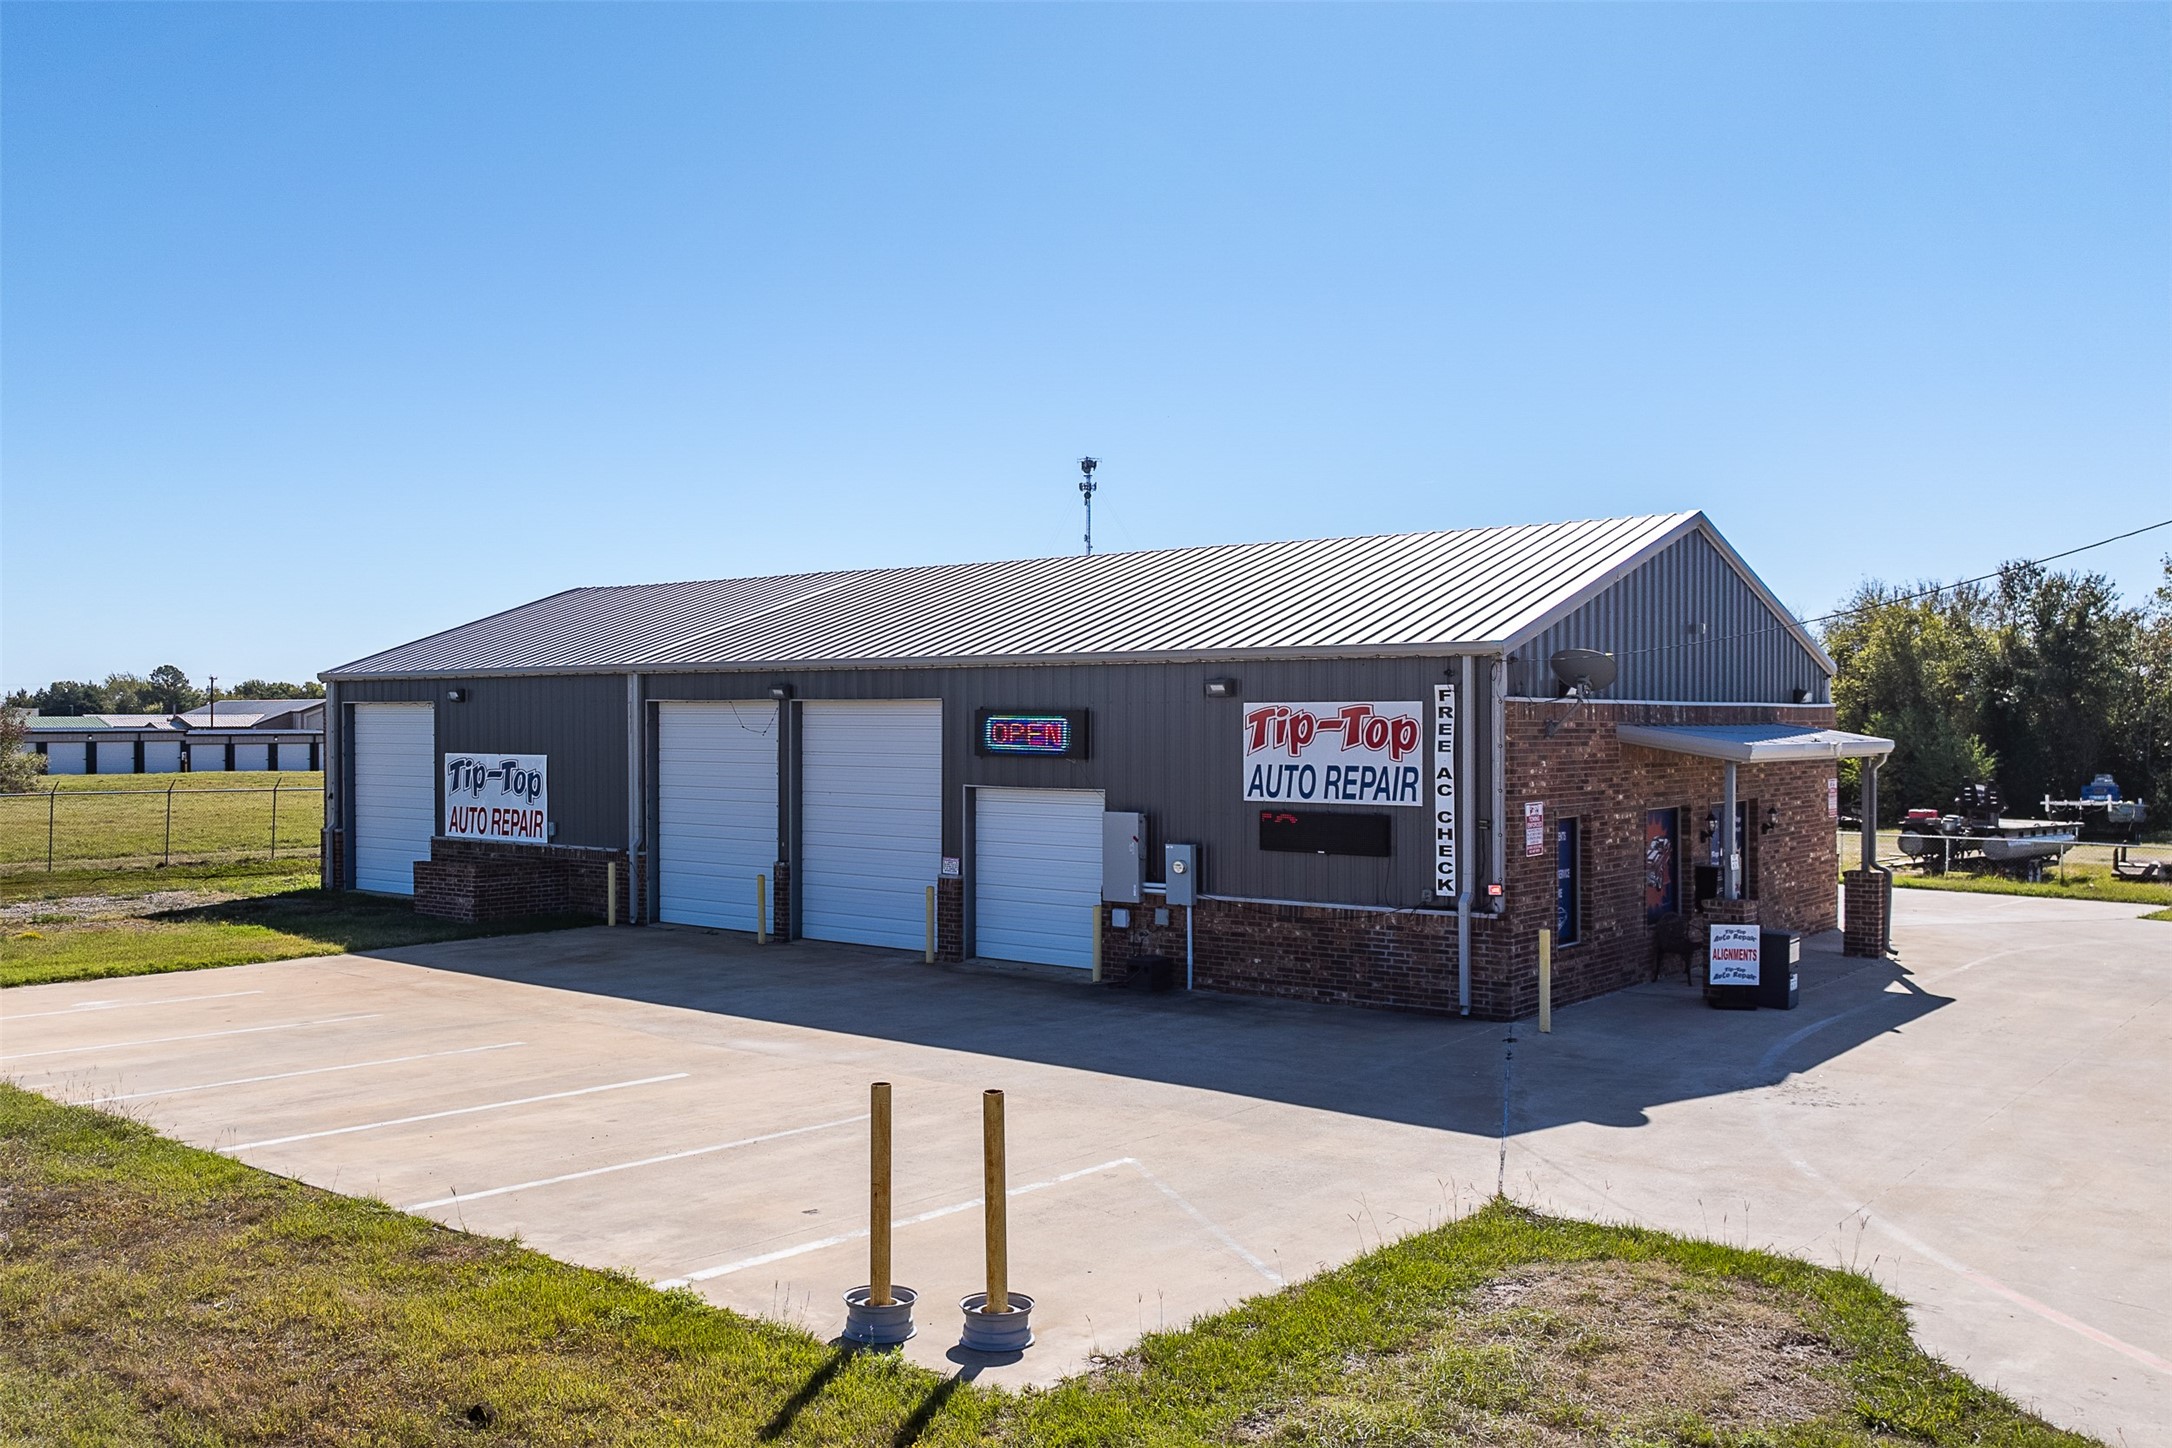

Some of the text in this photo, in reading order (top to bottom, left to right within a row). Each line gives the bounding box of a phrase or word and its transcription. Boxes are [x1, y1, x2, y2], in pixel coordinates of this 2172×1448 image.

[992, 723, 1062, 746] OPEN
[1245, 703, 1421, 762] Tip-Top
[448, 757, 543, 806] Tip-Top
[1247, 763, 1419, 802] AUTO REPAIR
[1437, 689, 1454, 892] FREE AC CHECK
[449, 806, 544, 839] AUTO REPAIR
[1713, 933, 1757, 942] Auto Repair
[1713, 948, 1757, 961] ALIGNMENTS
[1713, 971, 1757, 980] Auto Repair
